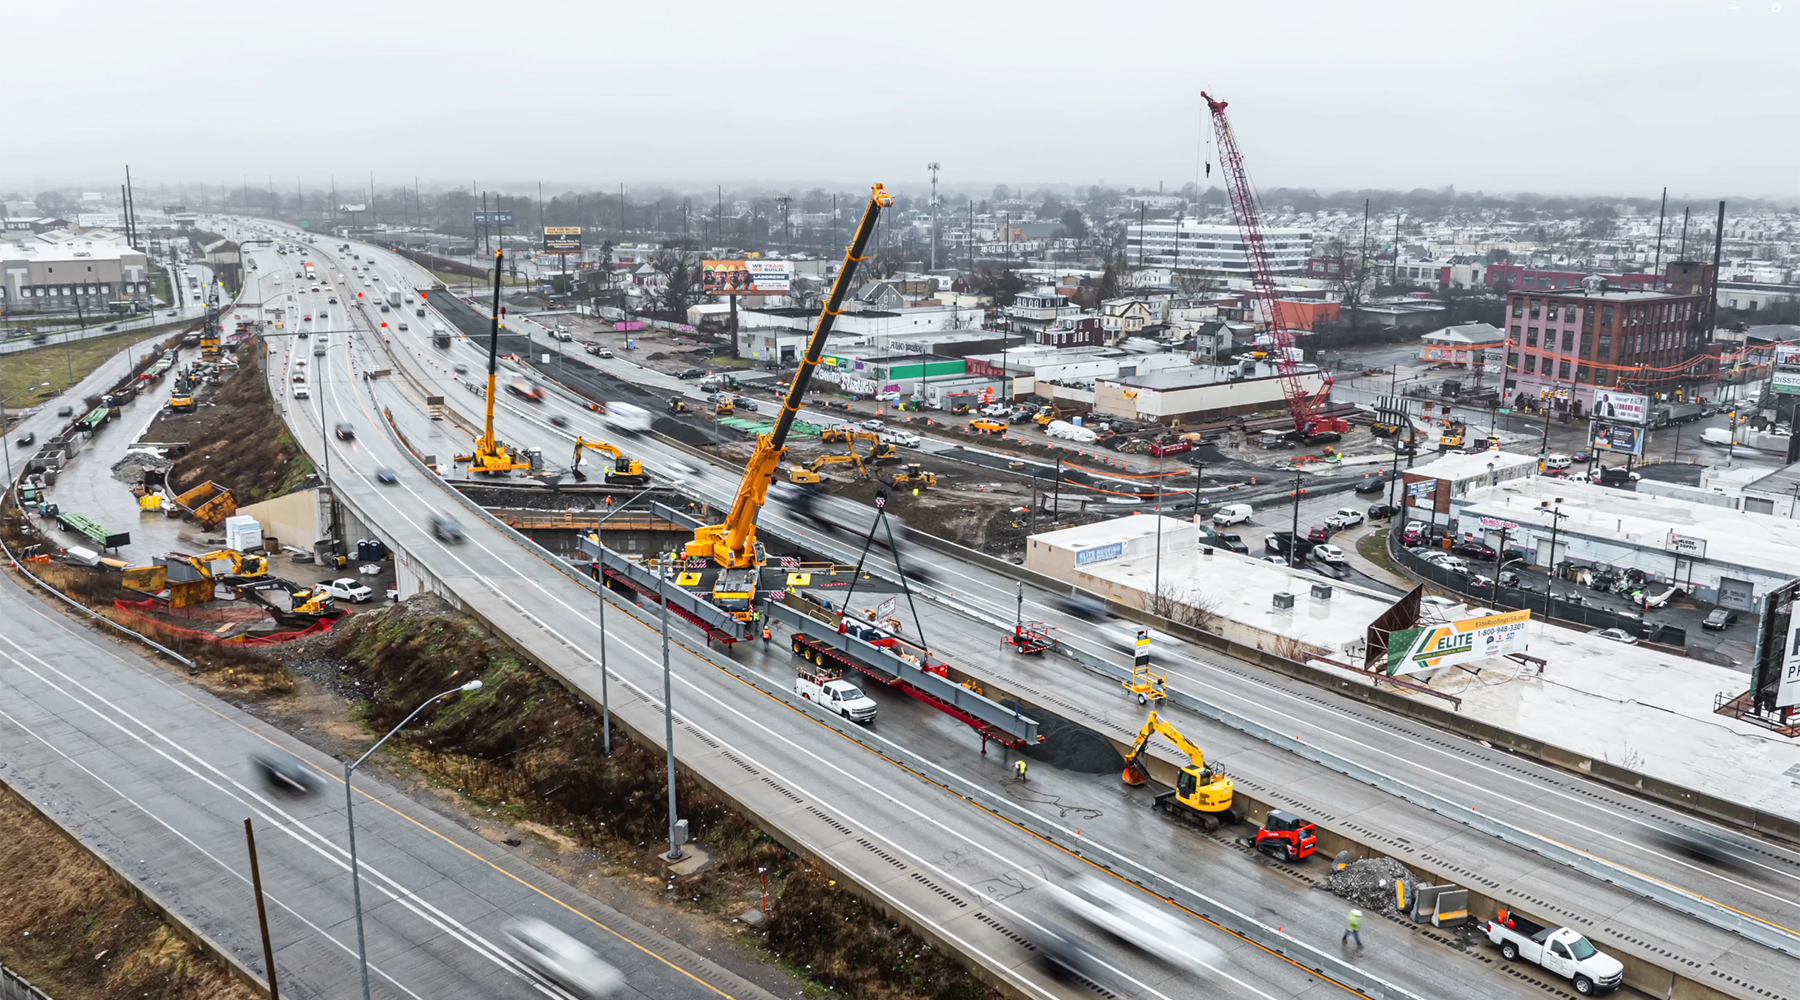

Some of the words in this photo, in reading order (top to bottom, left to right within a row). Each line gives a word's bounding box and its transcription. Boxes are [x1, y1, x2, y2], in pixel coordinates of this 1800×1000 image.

[1475, 614, 1527, 628] EliteRoofingUSA.net
[1478, 622, 1525, 637] 1-800-948-3301
[1438, 633, 1473, 650] ELITE
